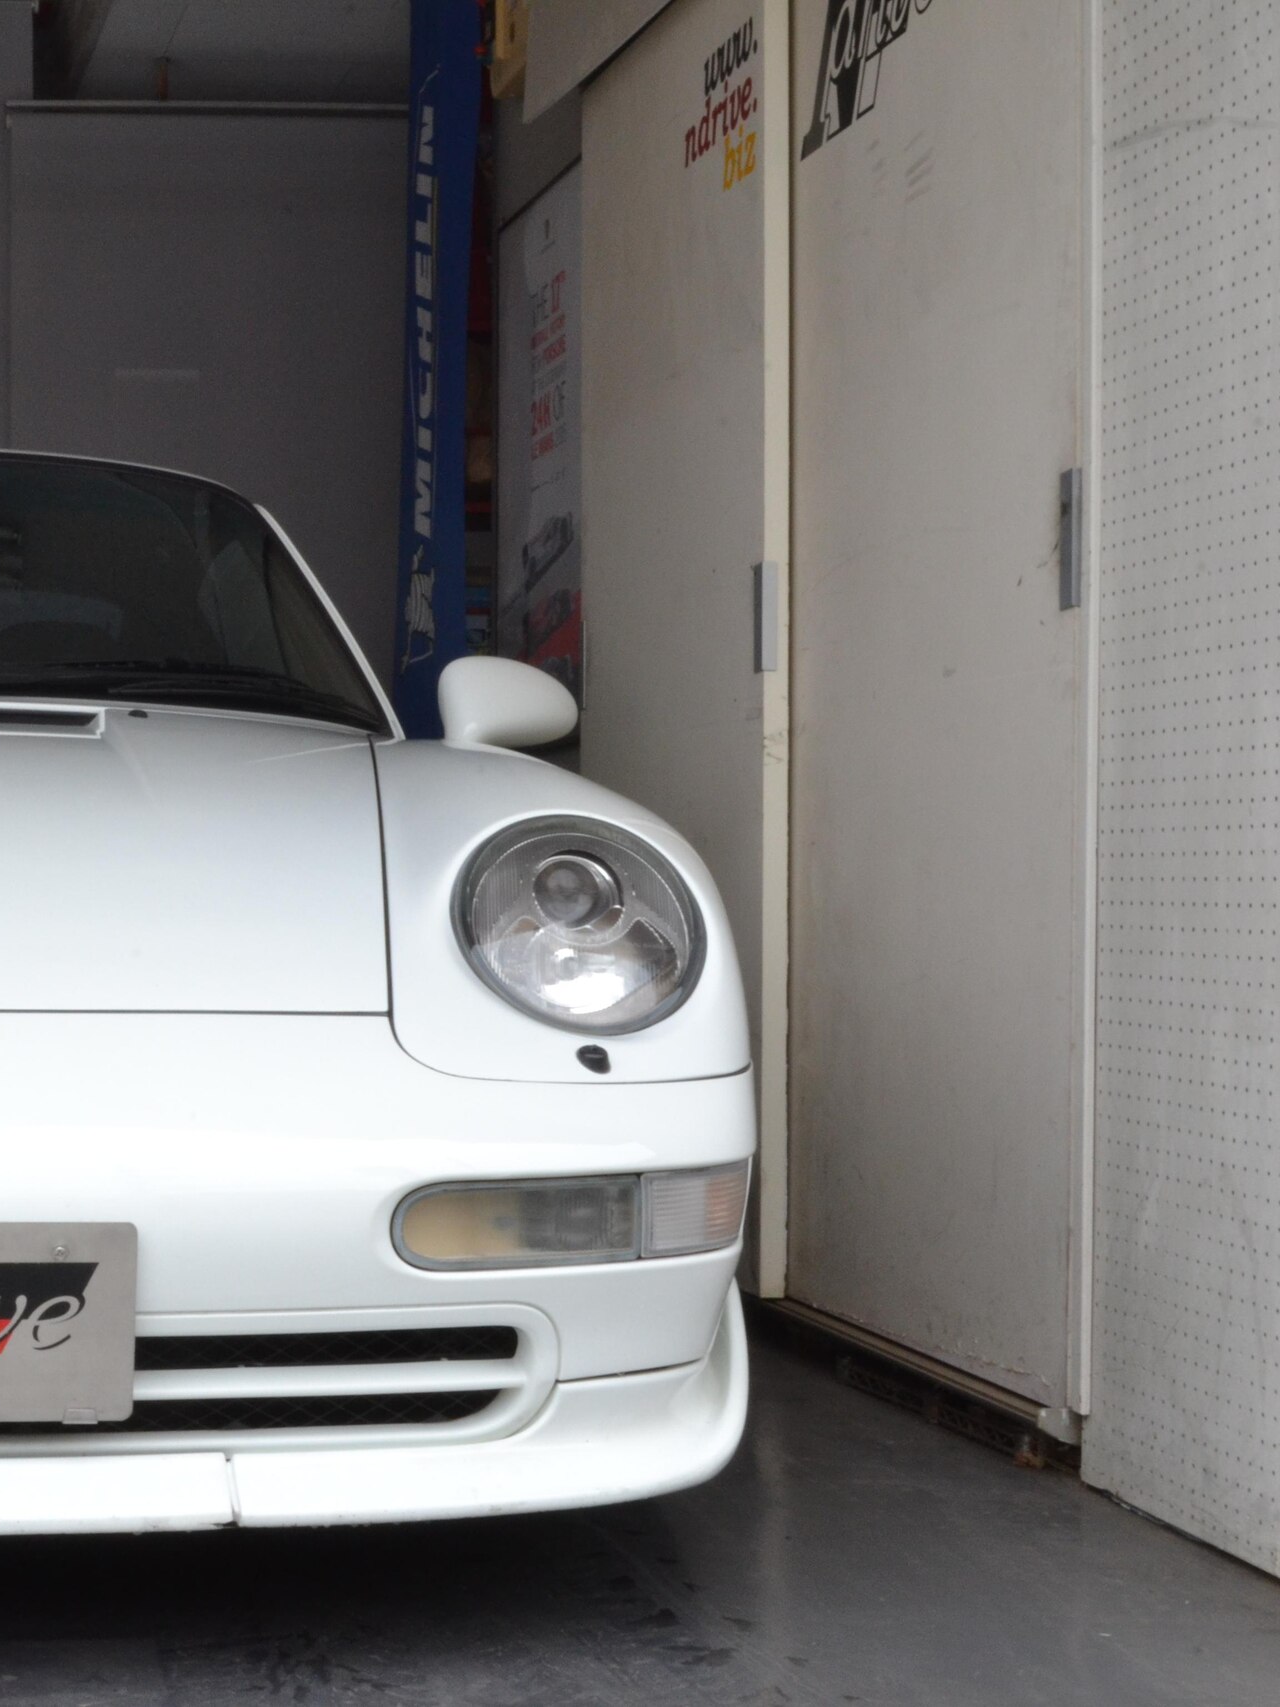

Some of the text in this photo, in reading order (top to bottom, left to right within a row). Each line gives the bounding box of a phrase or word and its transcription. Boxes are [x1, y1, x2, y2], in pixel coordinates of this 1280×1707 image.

[704, 17, 758, 96] www.
[684, 77, 758, 168] ndrive.
[723, 124, 757, 192] biz
[414, 105, 435, 540] MICHELIN
